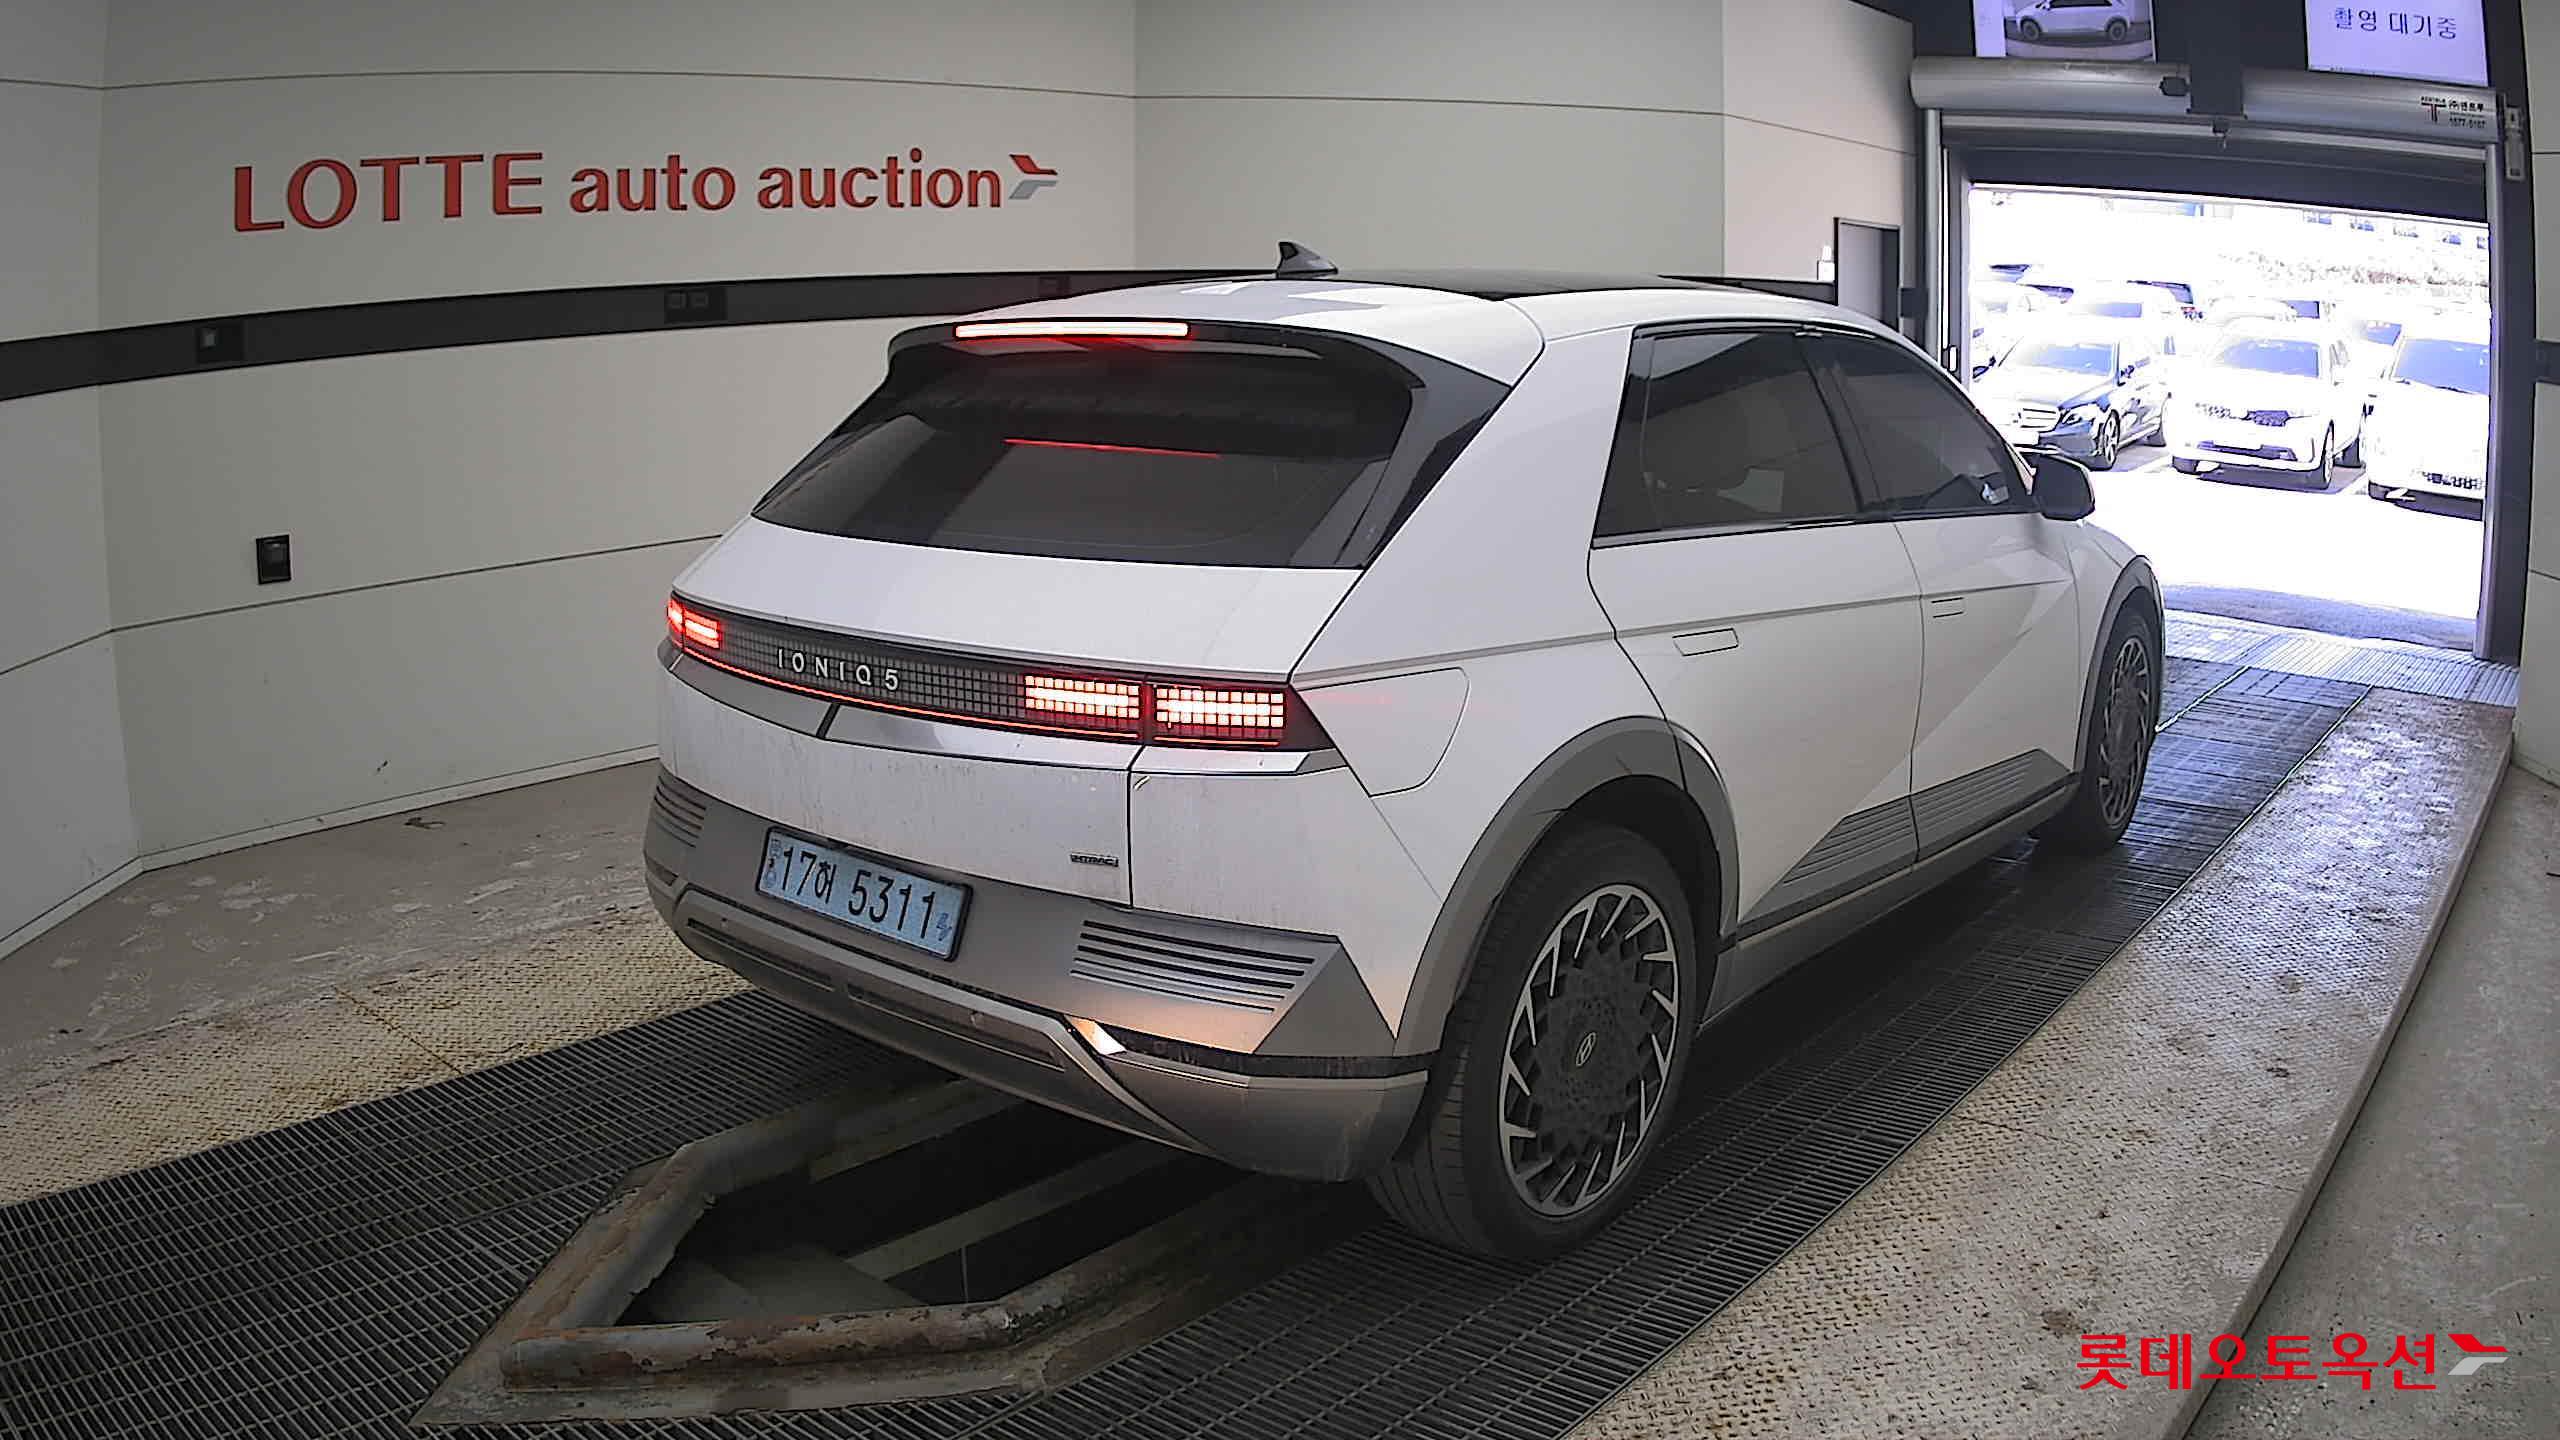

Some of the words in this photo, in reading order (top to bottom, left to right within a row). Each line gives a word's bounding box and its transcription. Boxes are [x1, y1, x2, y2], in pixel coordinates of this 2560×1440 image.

[2335, 8, 2377, 32] 촬영
[2389, 12, 2456, 40] 대기중
[234, 153, 543, 232] LOTTE
[569, 154, 735, 212] auto
[758, 147, 1002, 210] auction
[778, 648, 872, 686] IONIQ
[885, 668, 899, 691] 5
[848, 869, 936, 939] 5311
